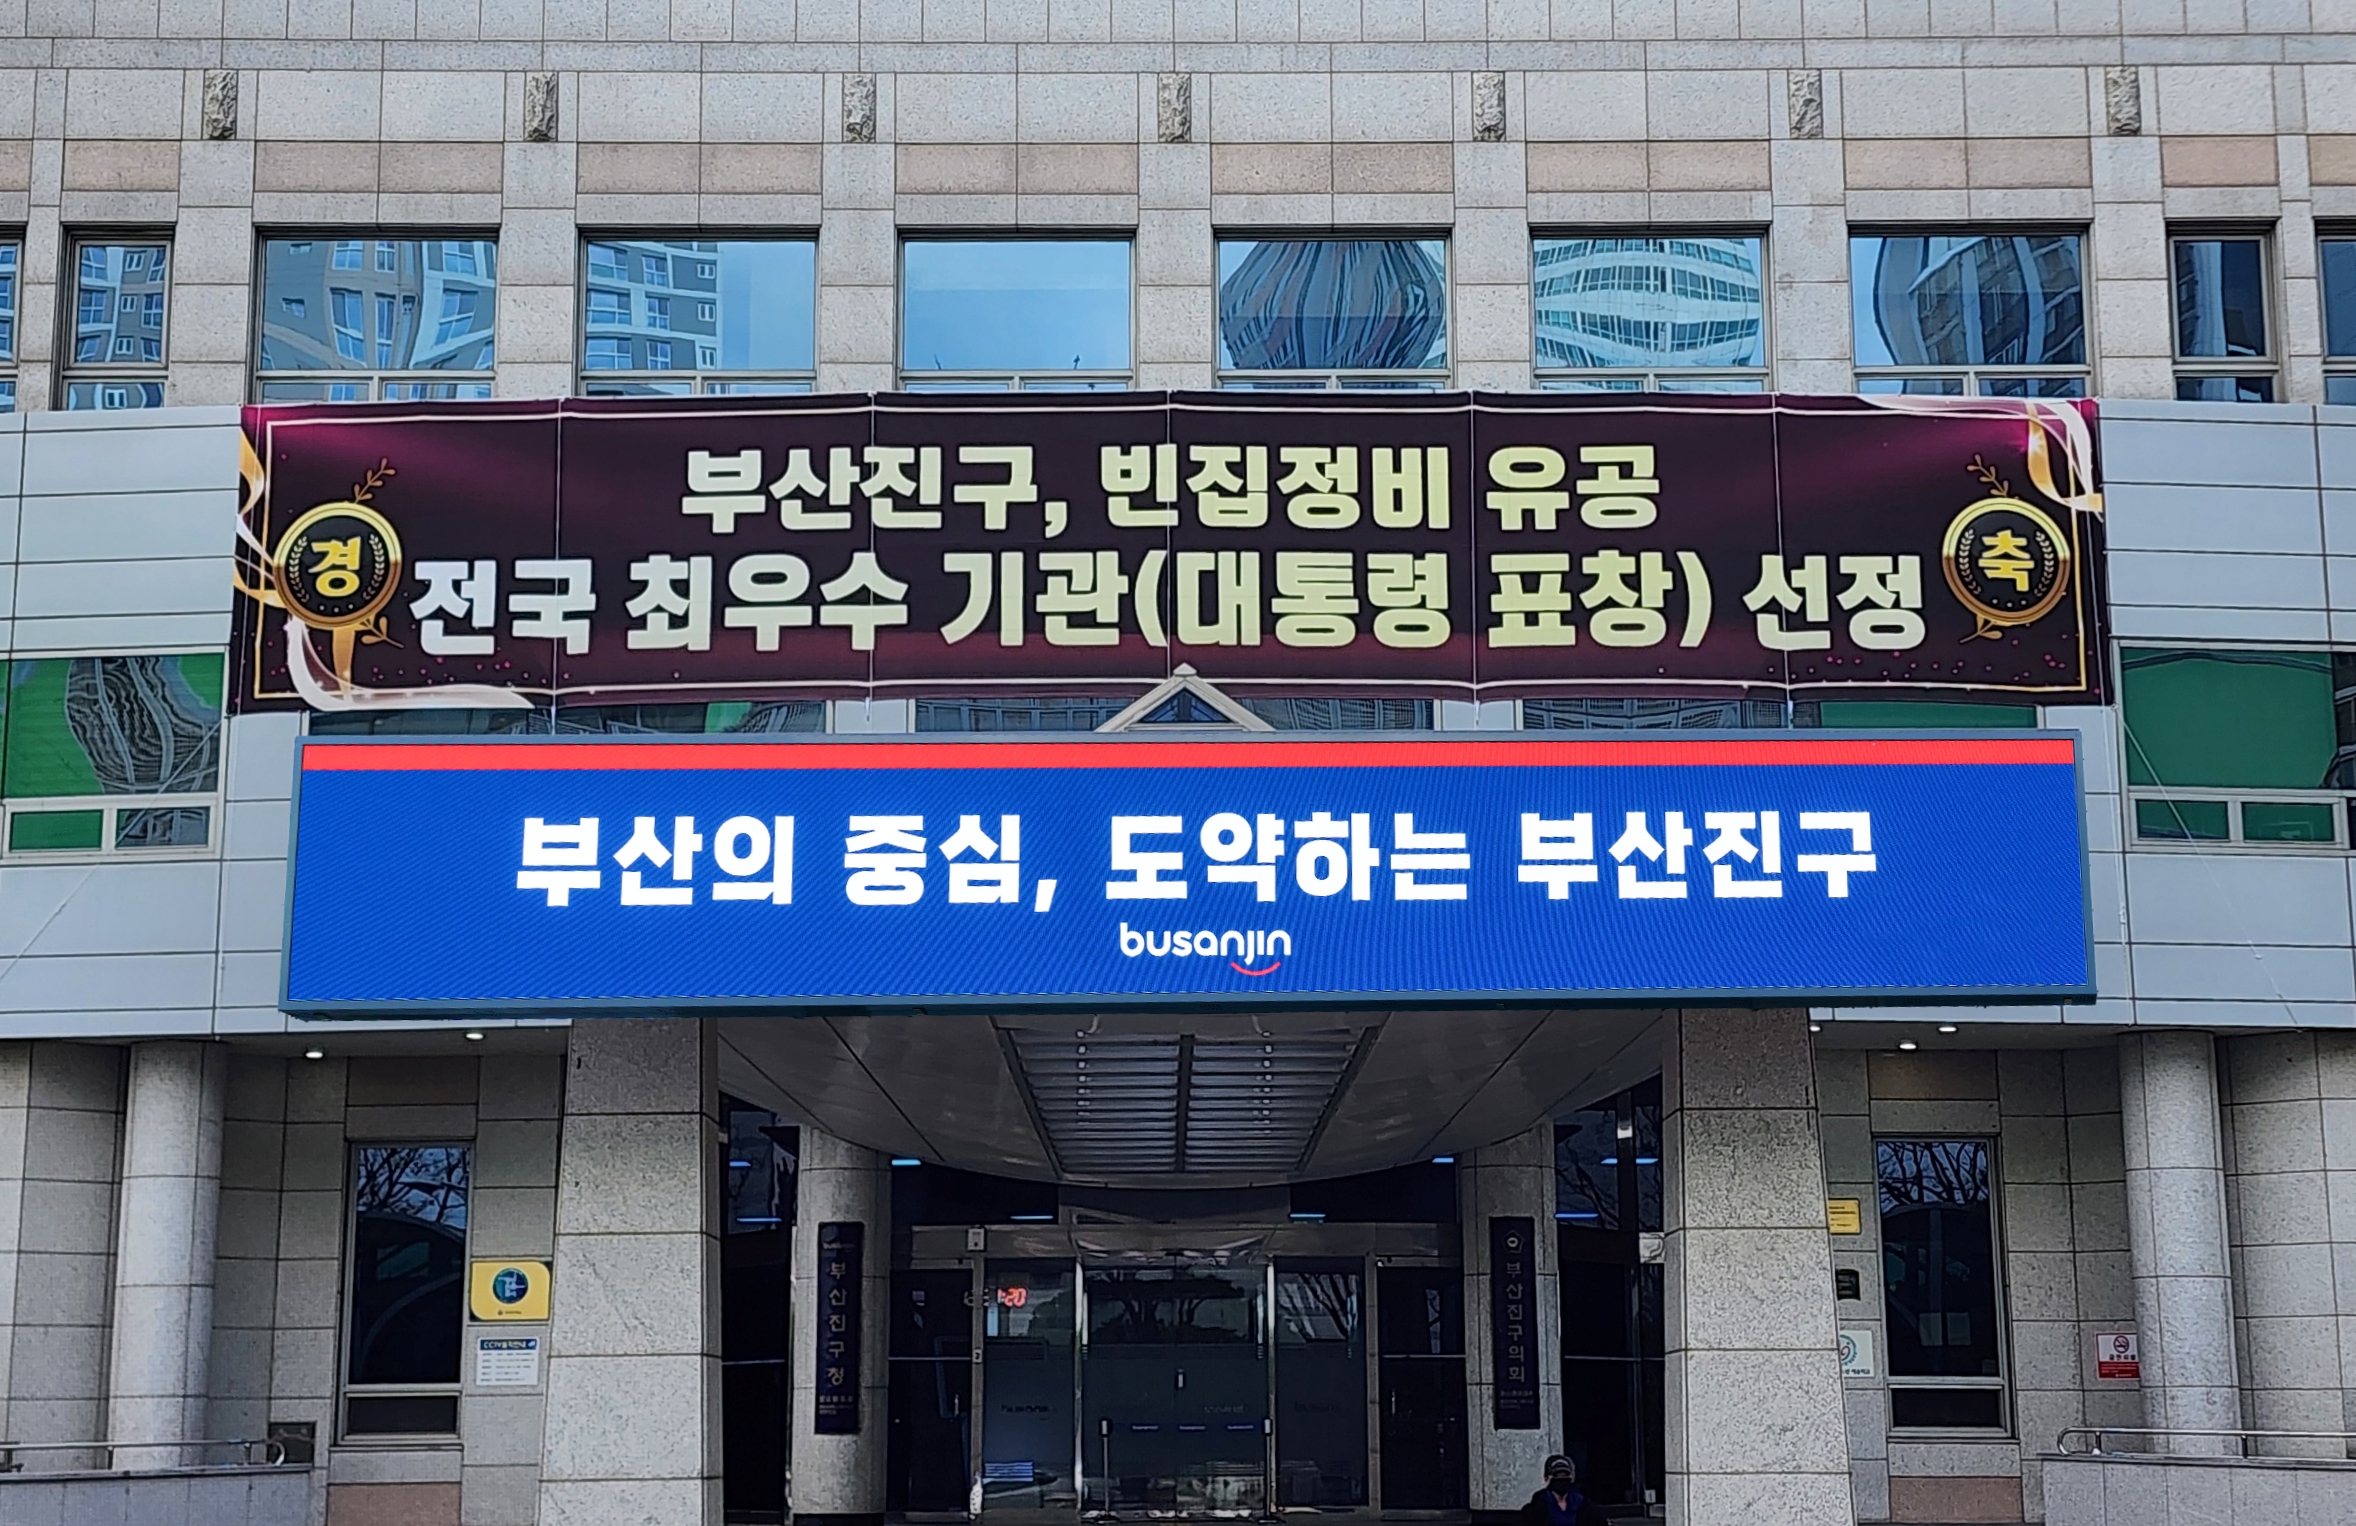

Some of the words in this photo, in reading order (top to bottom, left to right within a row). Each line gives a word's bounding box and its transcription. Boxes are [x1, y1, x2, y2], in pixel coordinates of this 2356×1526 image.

[682, 445, 1068, 538] 부산진구,
[1101, 445, 1450, 530] 빈집정비
[1486, 445, 1660, 530] 유공
[309, 537, 361, 597] 경
[409, 559, 597, 655] 전국
[625, 551, 909, 655] 최우수
[940, 550, 1451, 648] 기관(대통령
[1488, 550, 1712, 648] 표창)
[1742, 554, 1926, 652] 선정
[1979, 530, 2035, 592] 축
[517, 816, 795, 907] 부산의
[844, 815, 1058, 913] 중심,
[1105, 812, 1471, 903] 도약하는
[1517, 811, 1877, 901] 부산진구
[1119, 922, 1292, 966] busanjin
[827, 1261, 848, 1387] 부산진구청
[1506, 1261, 1525, 1383] 부산진구의회
